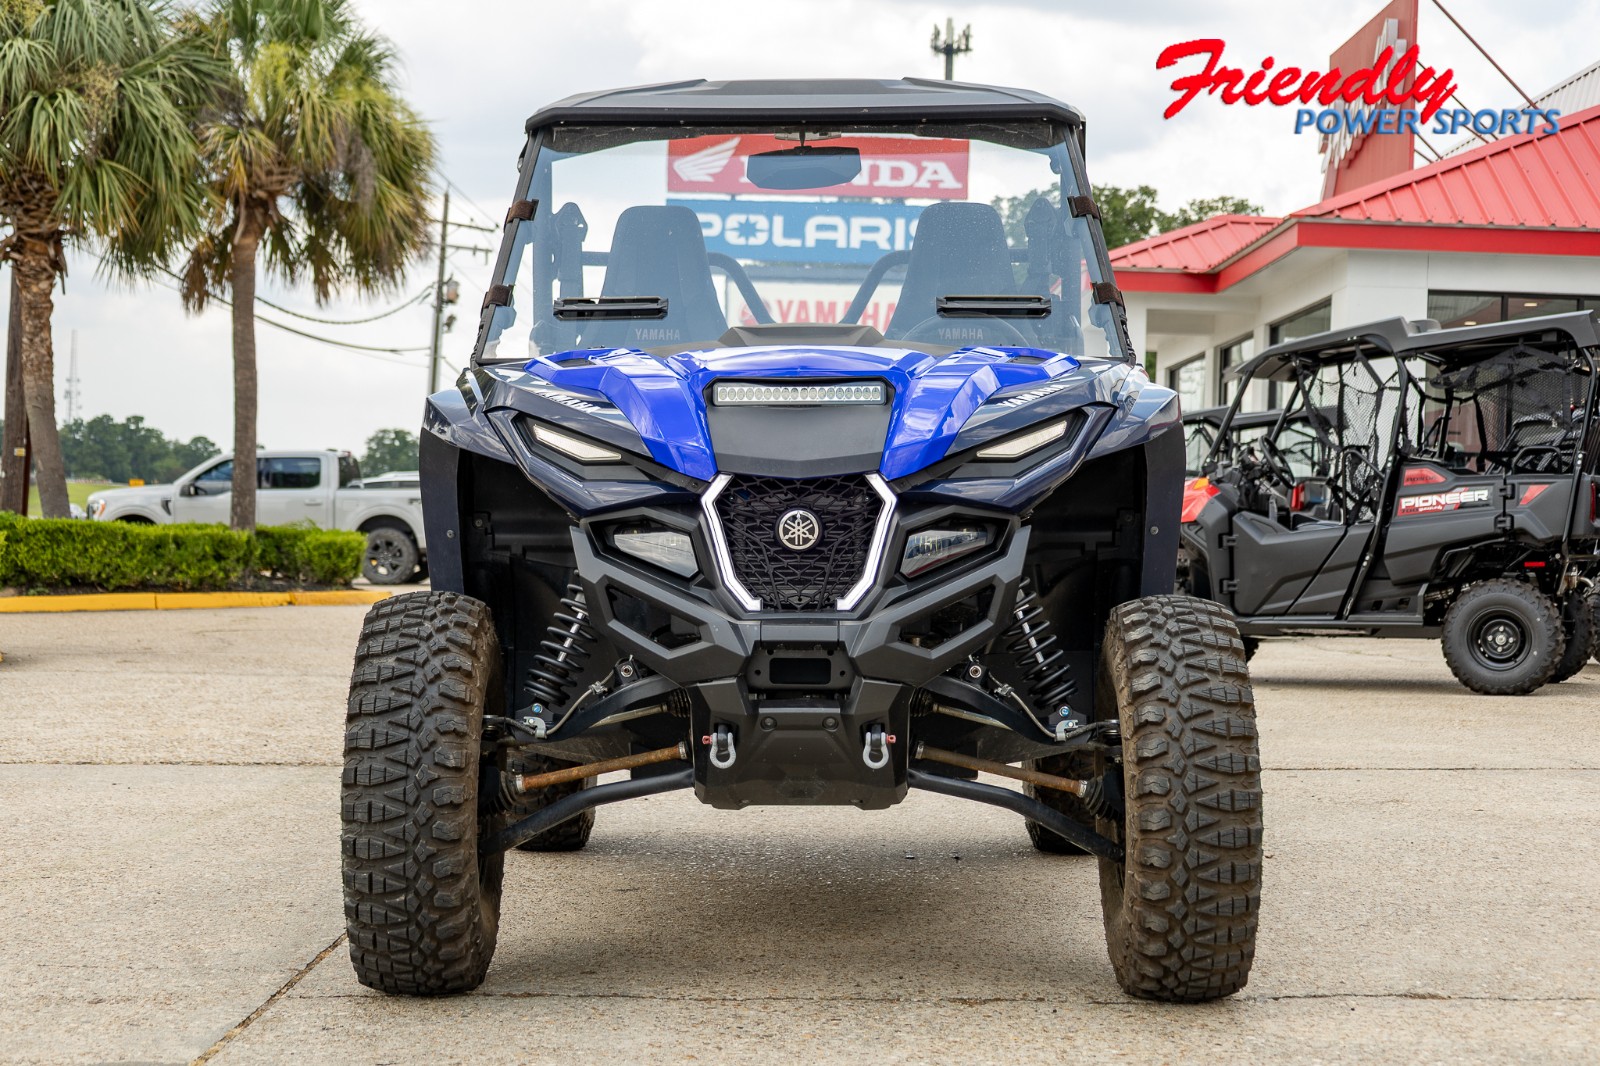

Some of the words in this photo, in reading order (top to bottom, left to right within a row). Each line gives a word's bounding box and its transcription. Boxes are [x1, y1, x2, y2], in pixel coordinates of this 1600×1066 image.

[696, 213, 917, 251] POLARI
[635, 328, 680, 341] YAMAHA
[938, 328, 984, 340] YAMAHA
[995, 384, 1071, 408] YAMAHA
[1401, 489, 1489, 509] PIONEER
